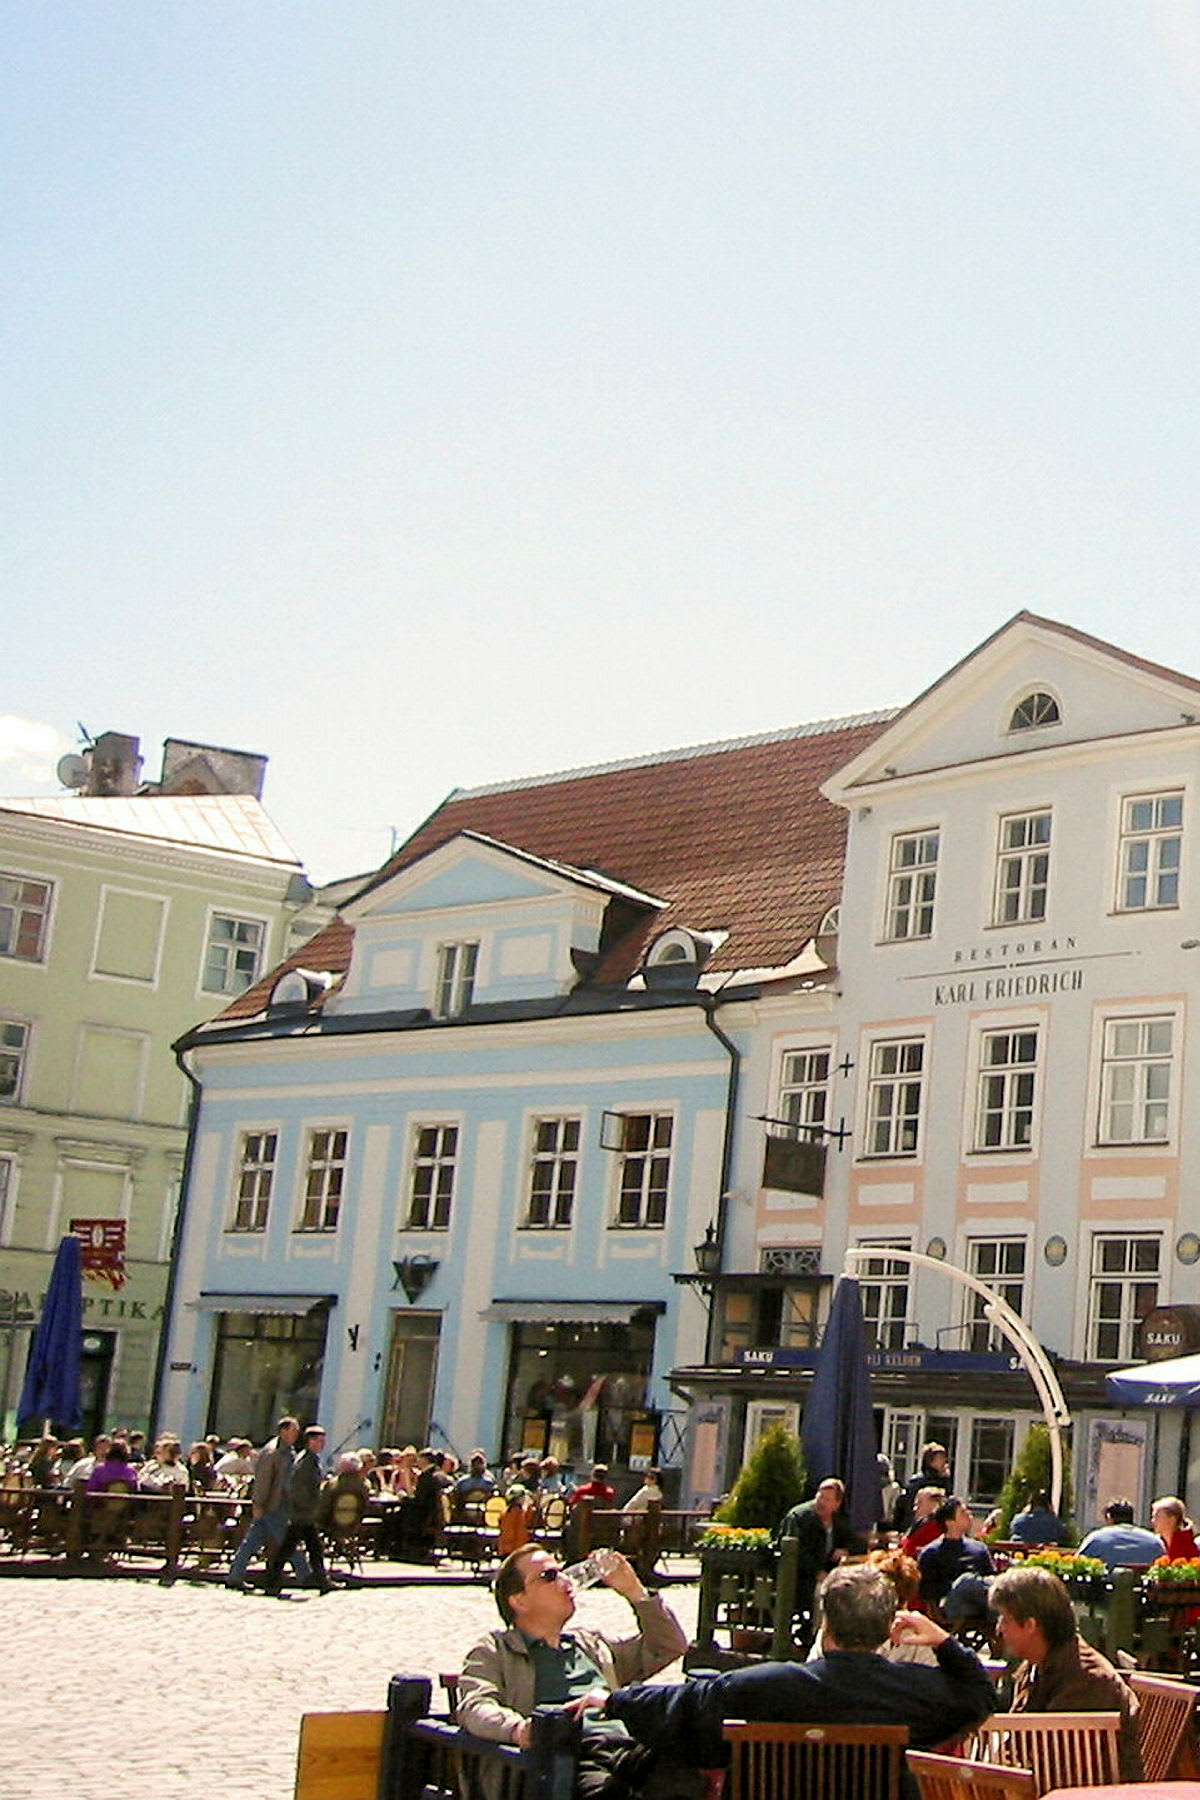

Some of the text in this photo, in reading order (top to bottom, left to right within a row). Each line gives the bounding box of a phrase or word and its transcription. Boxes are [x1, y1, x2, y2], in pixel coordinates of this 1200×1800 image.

[953, 937, 1077, 963] RESTORAN
[934, 969, 1084, 1006] KARL FRIEDRICH
[1147, 1332, 1181, 1345] SAKU
[743, 1350, 774, 1363] SAKU
